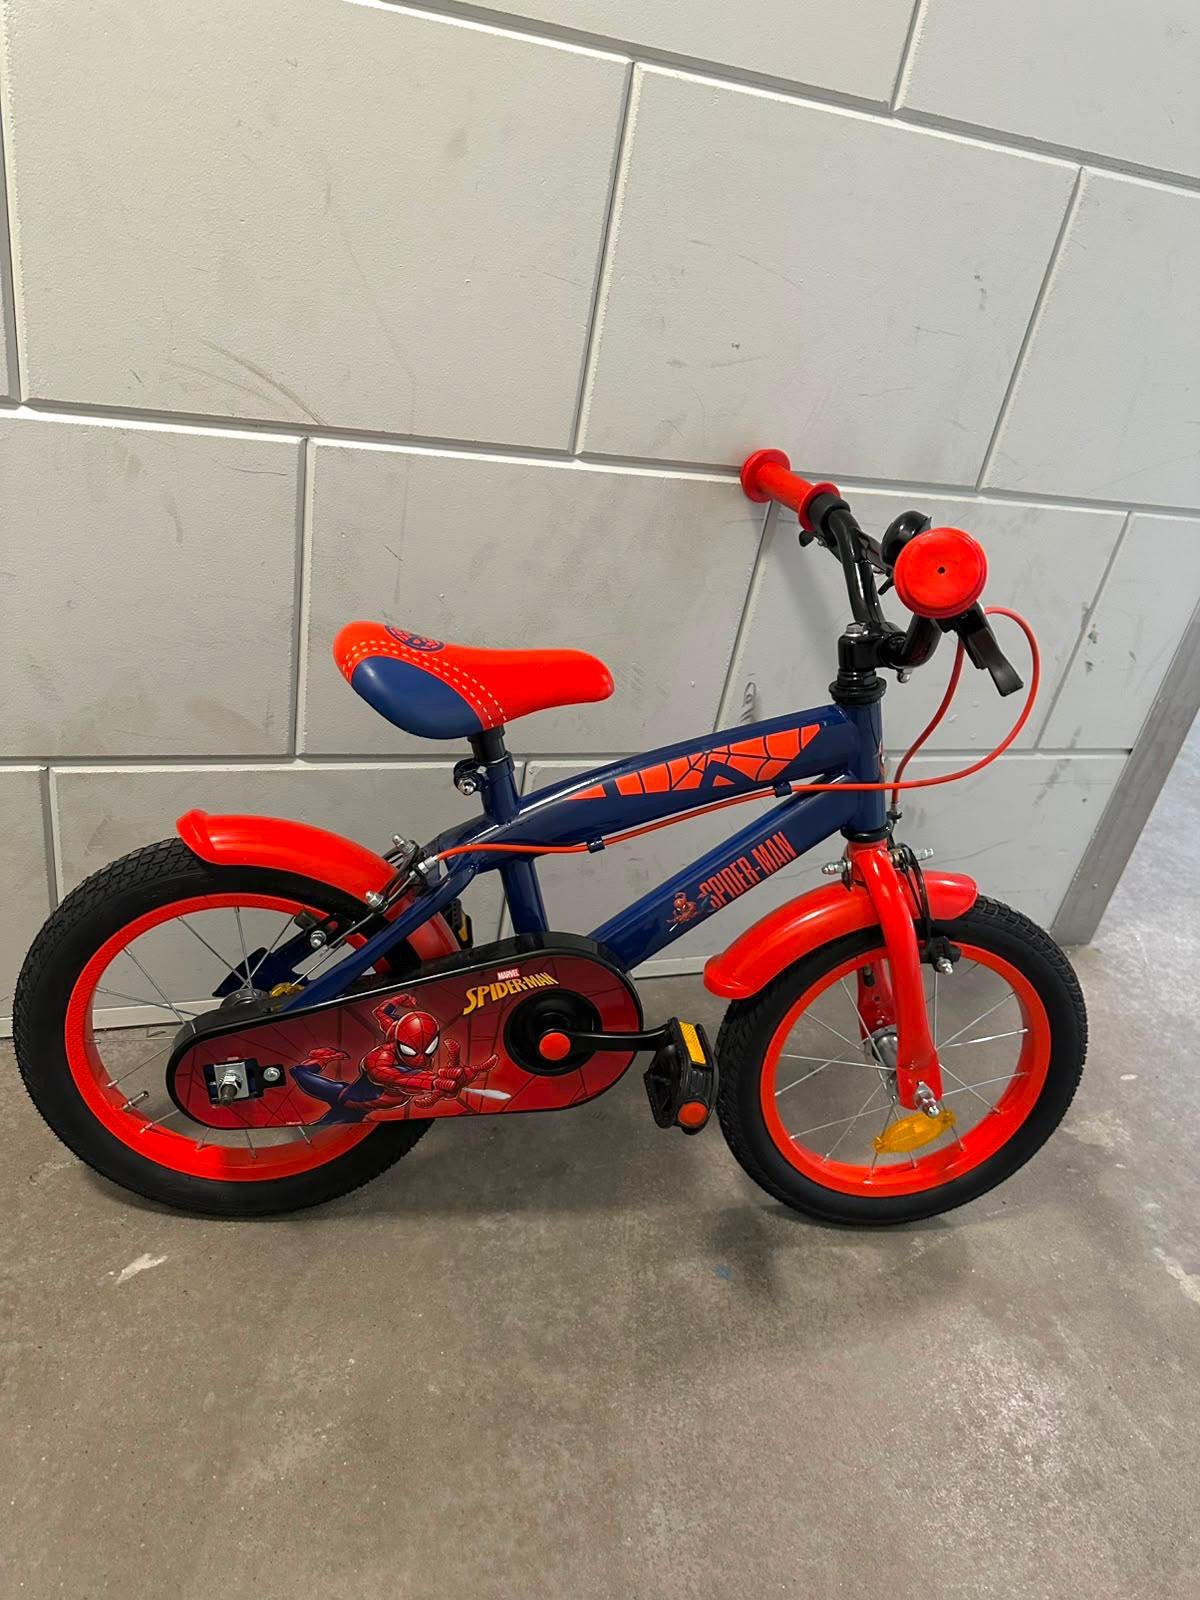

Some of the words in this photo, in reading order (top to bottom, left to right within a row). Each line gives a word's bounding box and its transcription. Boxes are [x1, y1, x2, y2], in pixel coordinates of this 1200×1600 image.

[698, 831, 798, 909] SPIDER-MAN
[463, 972, 559, 1015] SPIDER-MAN
[497, 968, 520, 980] MARVEL
